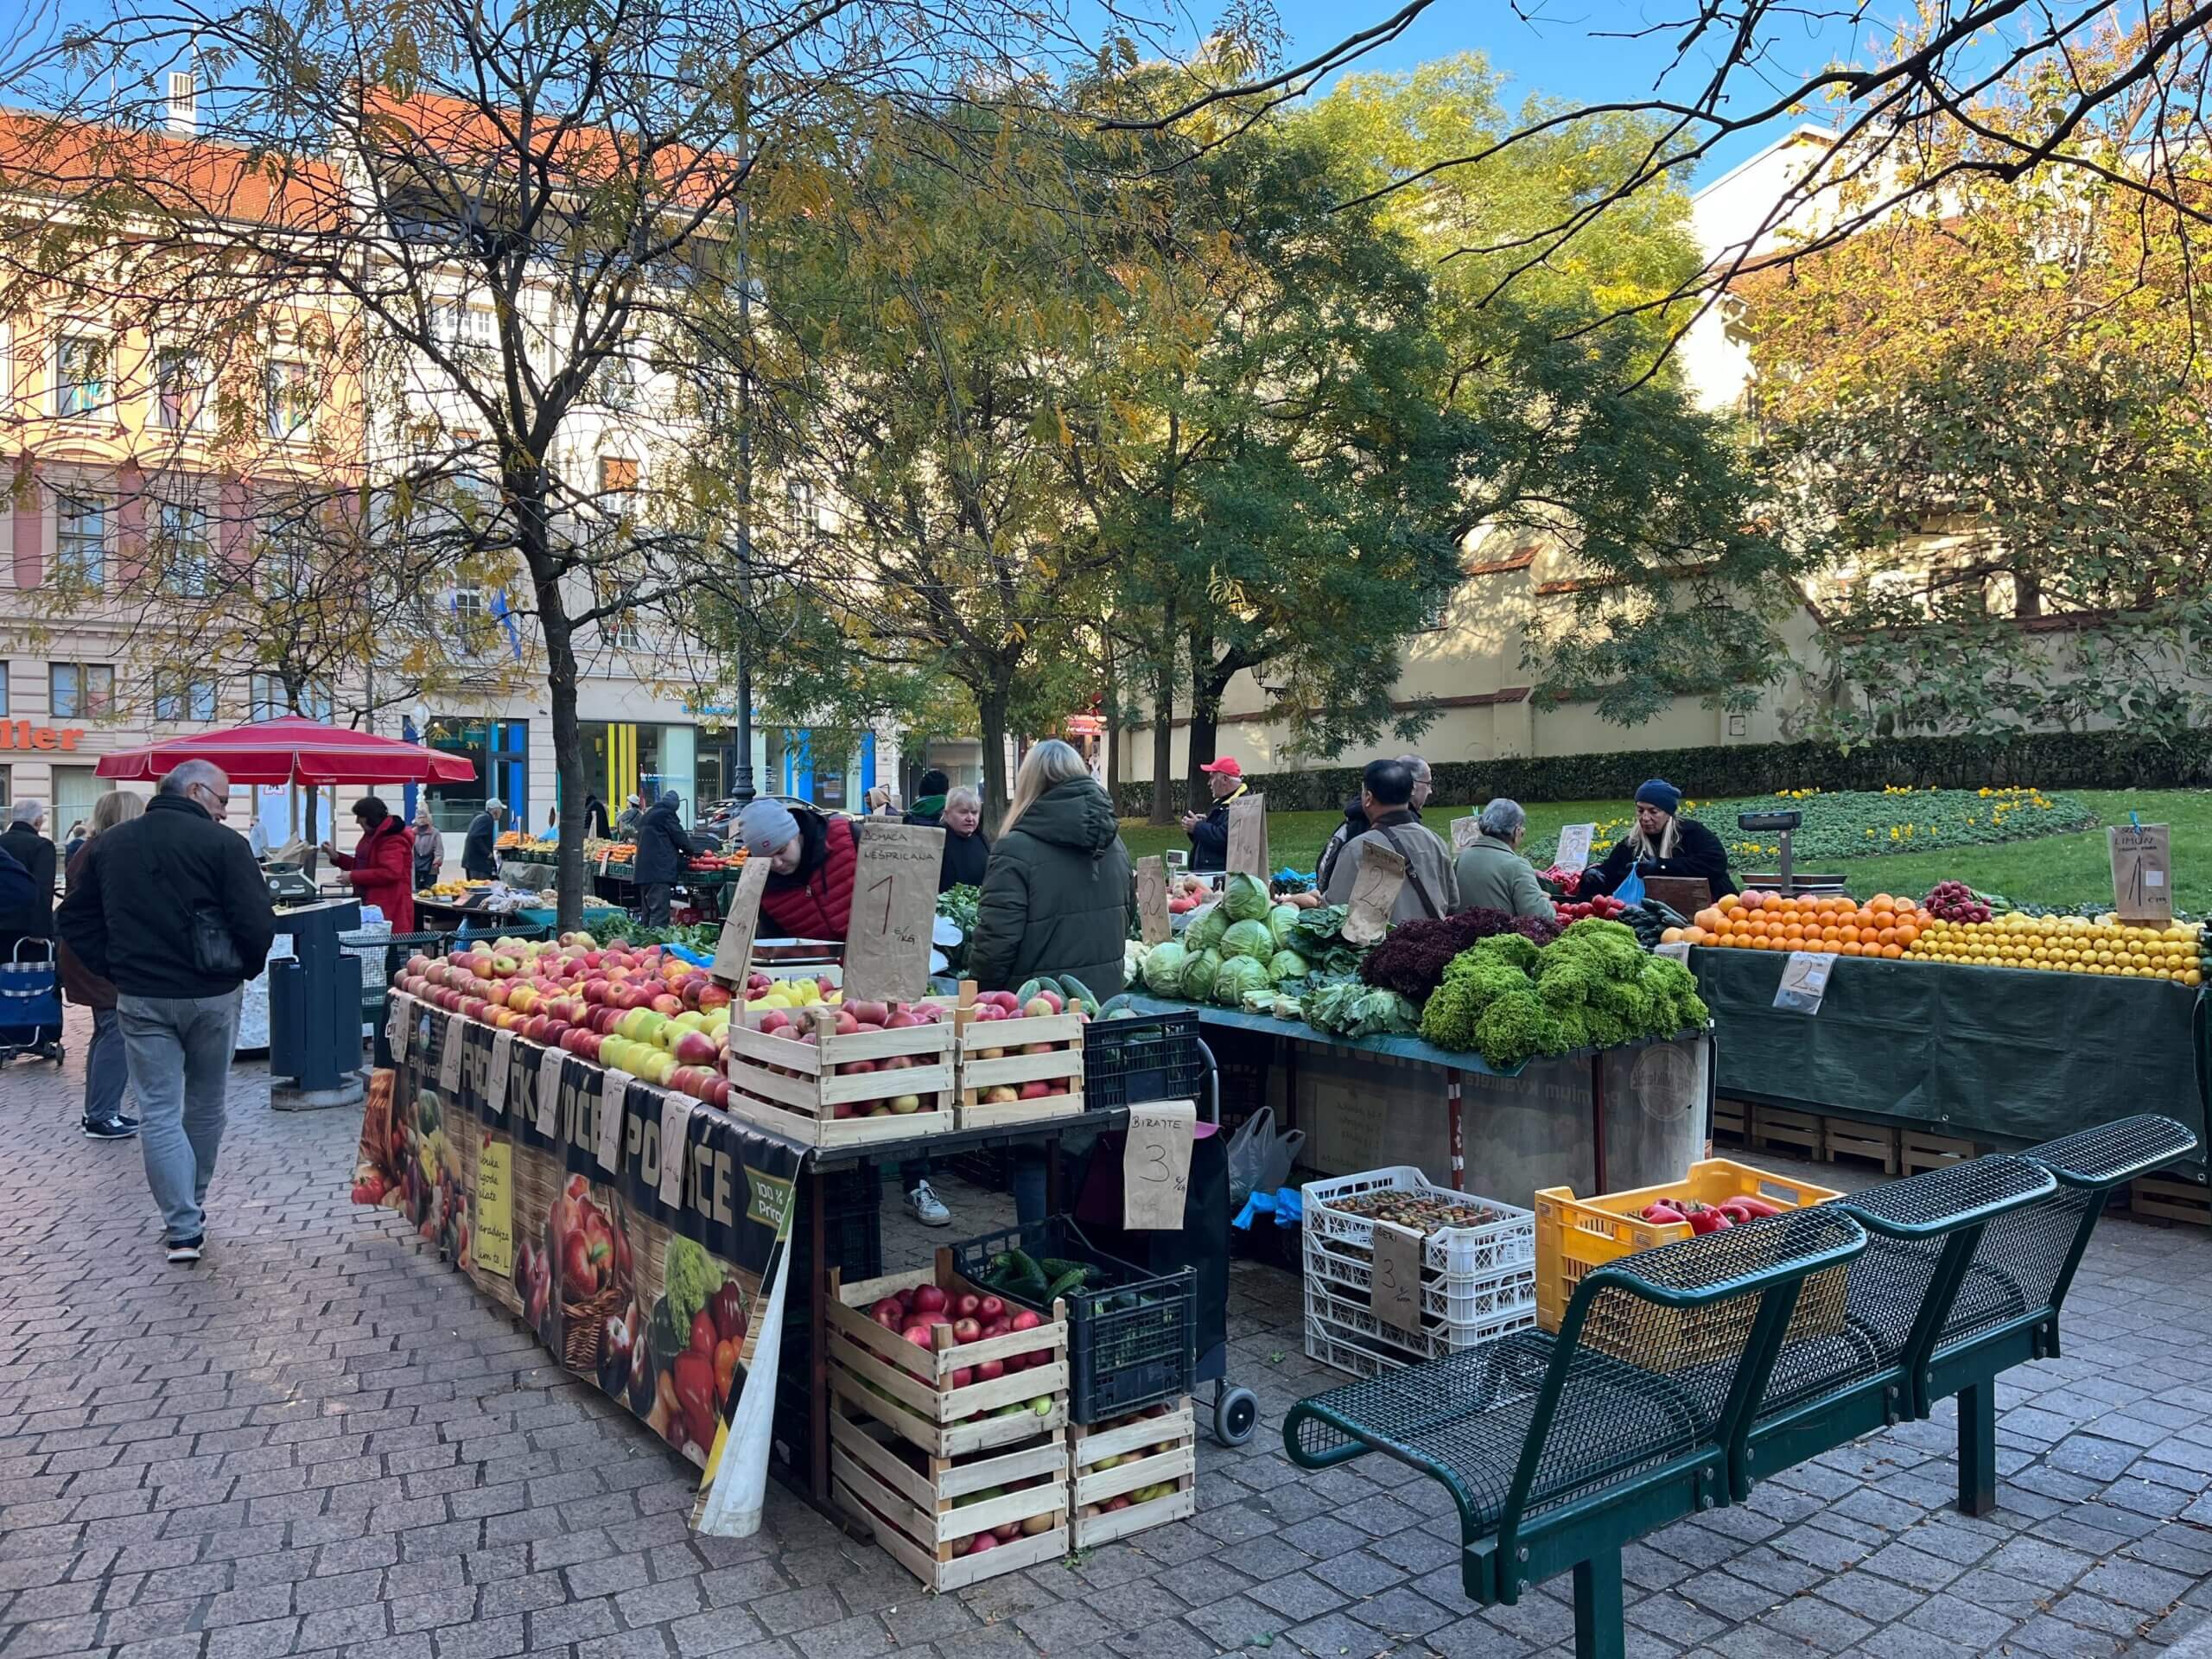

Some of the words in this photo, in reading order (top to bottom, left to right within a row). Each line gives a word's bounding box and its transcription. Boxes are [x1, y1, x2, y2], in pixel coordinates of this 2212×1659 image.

[2114, 836, 2153, 845] LIMUN
[1143, 877, 1161, 917] 2
[1359, 865, 1383, 907] 2
[2128, 855, 2142, 906] 1
[868, 874, 893, 936] 1
[1790, 959, 1813, 990] 2
[1139, 1144, 1170, 1183] 3
[756, 1181, 773, 1200] 100
[775, 1189, 783, 1205] %
[1381, 1258, 1396, 1289] 3
